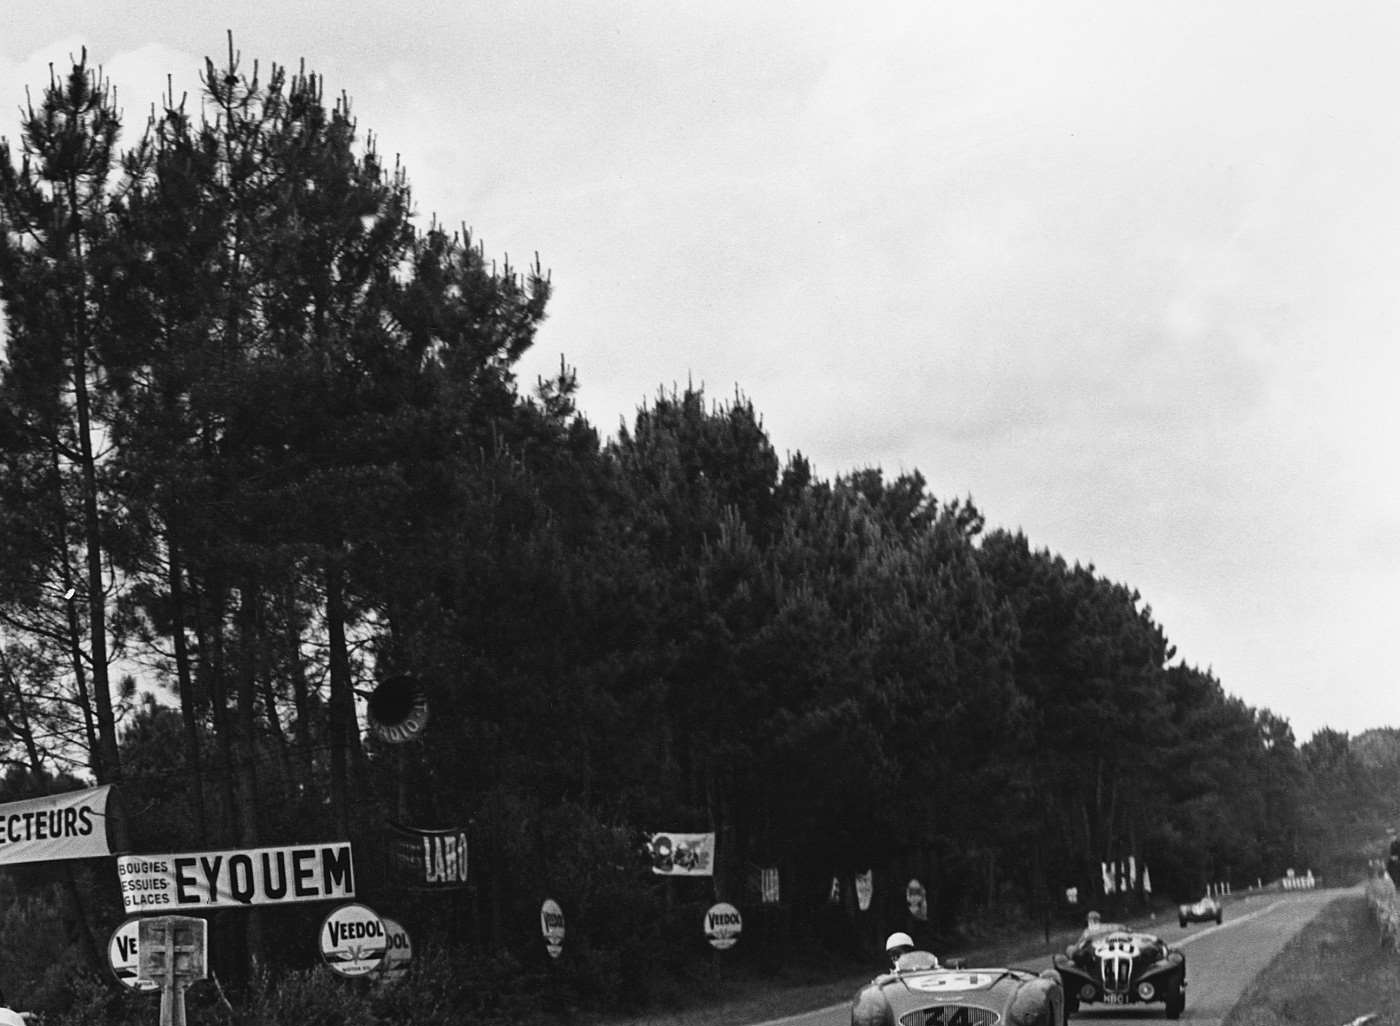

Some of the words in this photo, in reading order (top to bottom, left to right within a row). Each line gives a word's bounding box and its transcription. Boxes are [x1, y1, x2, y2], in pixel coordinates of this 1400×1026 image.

[119, 861, 169, 876] BOUGIES
[174, 846, 353, 905] EYQUEM
[124, 893, 170, 906] GLACES
[328, 920, 384, 948] VEEDOL
